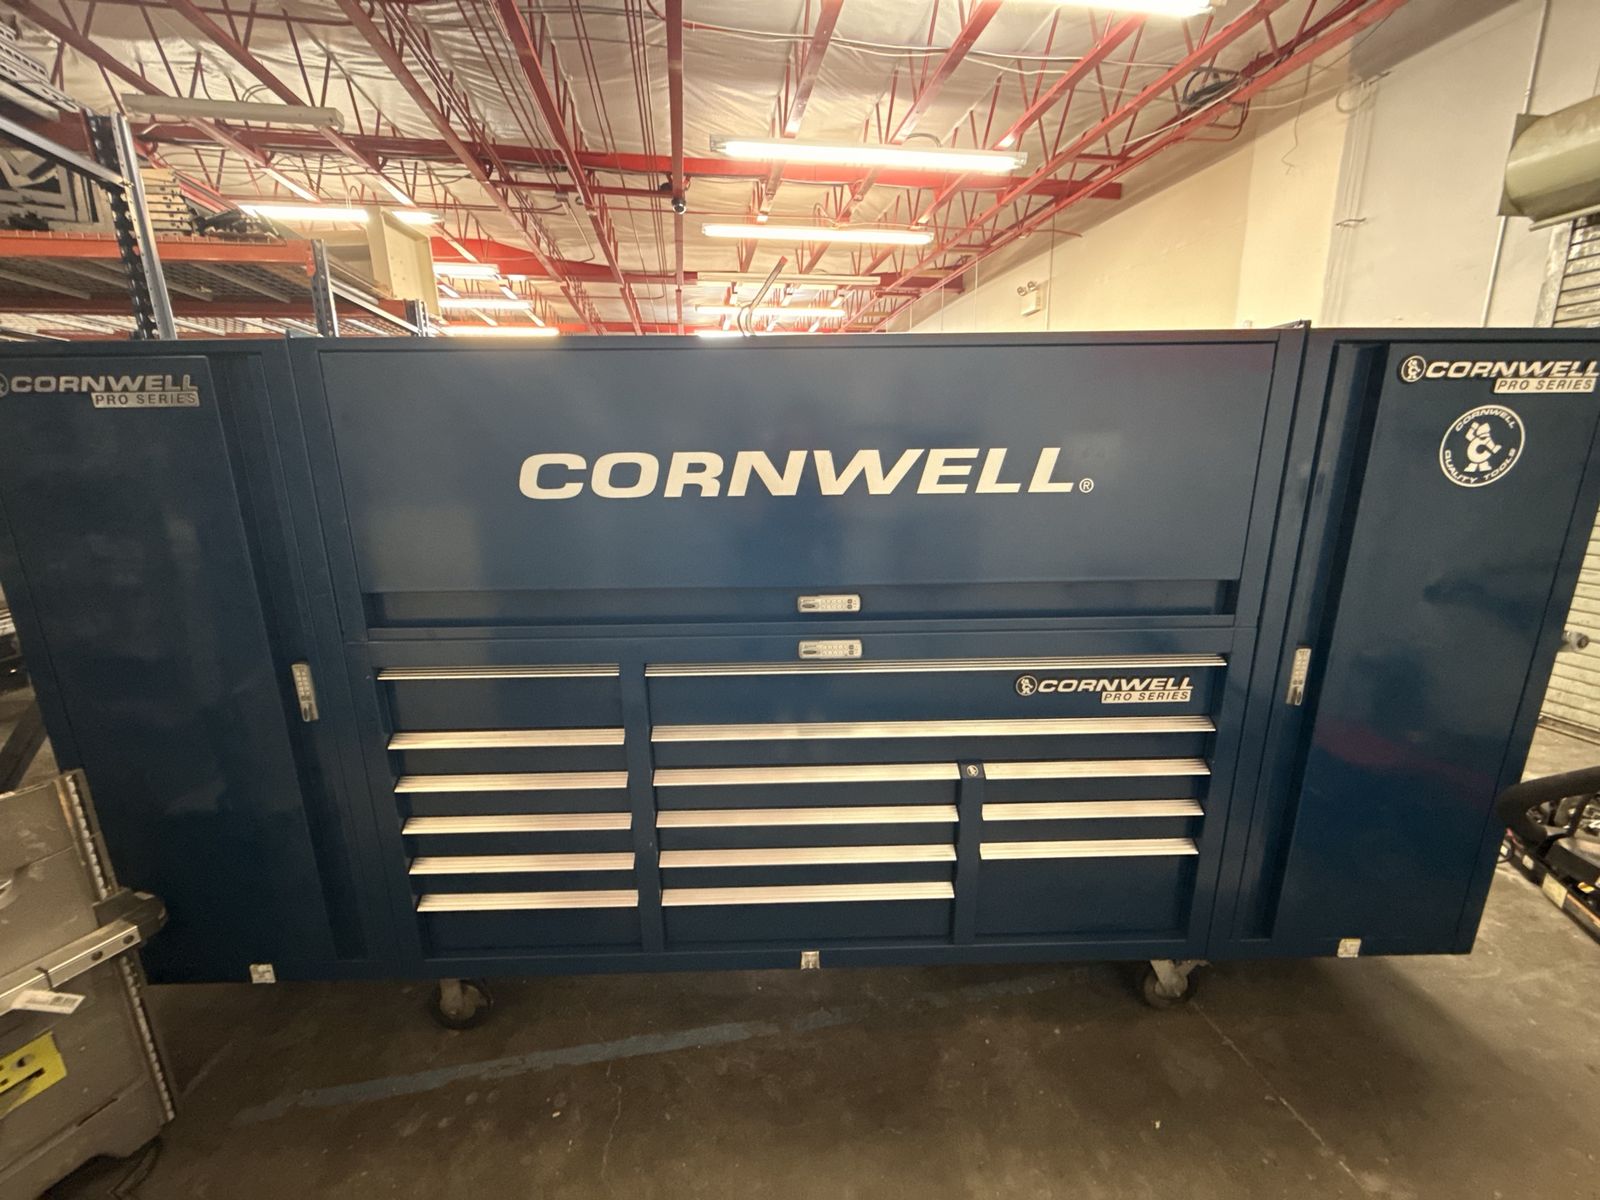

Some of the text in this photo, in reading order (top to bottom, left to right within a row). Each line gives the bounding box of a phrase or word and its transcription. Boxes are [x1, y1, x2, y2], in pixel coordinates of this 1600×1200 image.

[1425, 361, 1599, 378] CORNWELL
[10, 374, 199, 393] CORNWELL
[1499, 379, 1593, 391] PRO SERIES
[94, 393, 196, 406] PRO SERIES
[1455, 408, 1516, 432] CORNWELL
[1444, 448, 1517, 483] QUALITY TOOLS
[1037, 676, 1194, 693] CORNWELL
[1104, 692, 1189, 702] PRO SERIES
